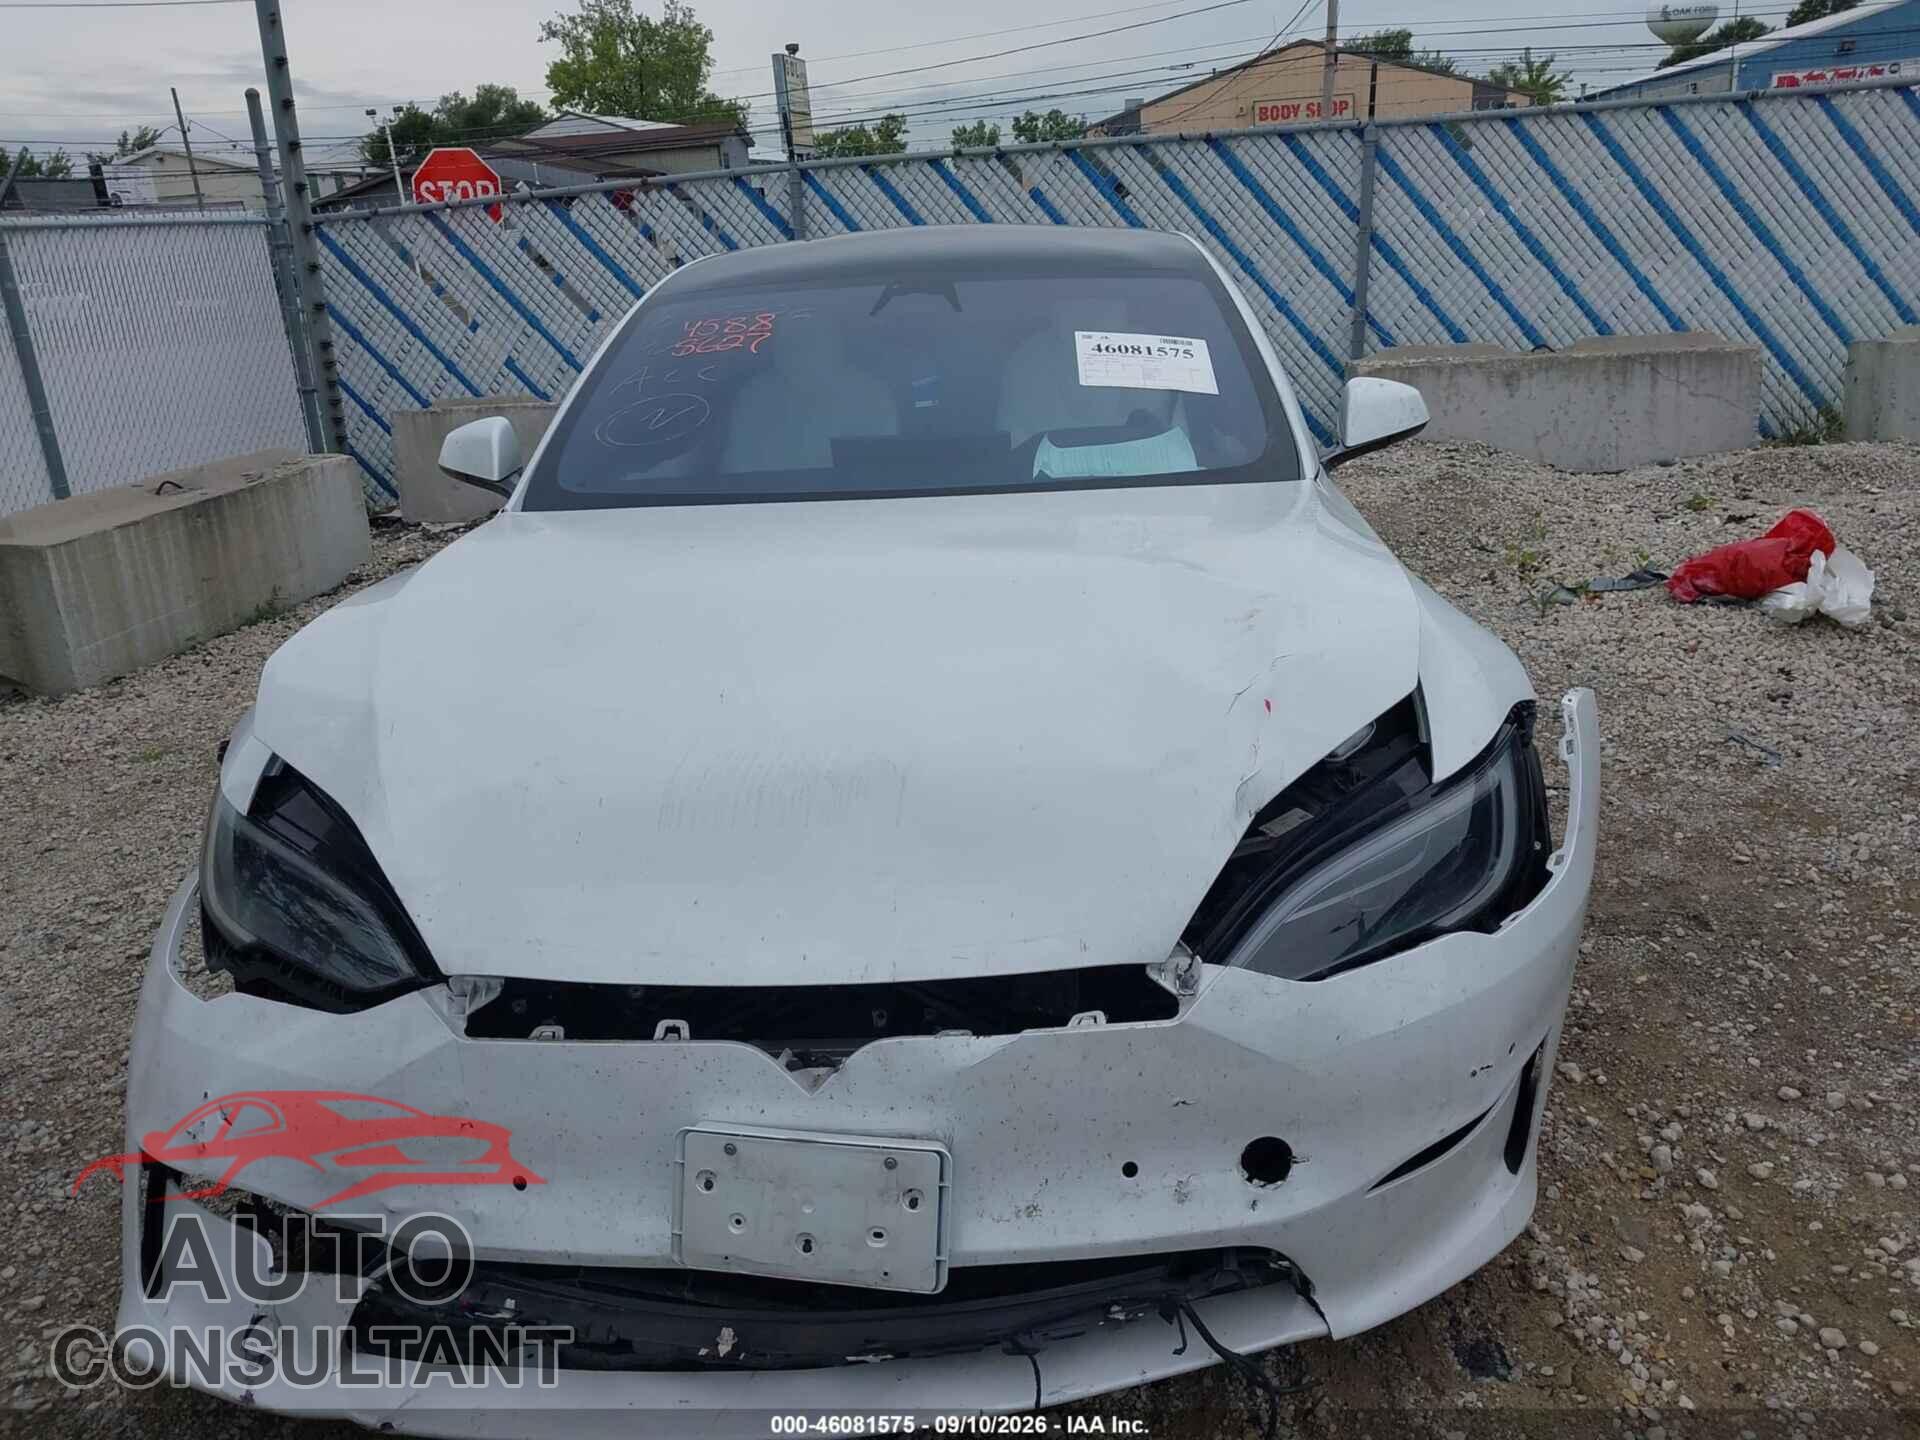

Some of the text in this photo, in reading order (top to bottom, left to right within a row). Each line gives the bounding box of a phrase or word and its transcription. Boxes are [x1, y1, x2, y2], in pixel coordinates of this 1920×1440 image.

[1258, 104, 1301, 121] BODY
[420, 180, 495, 204] STOP
[1091, 343, 1194, 360] 46081575
